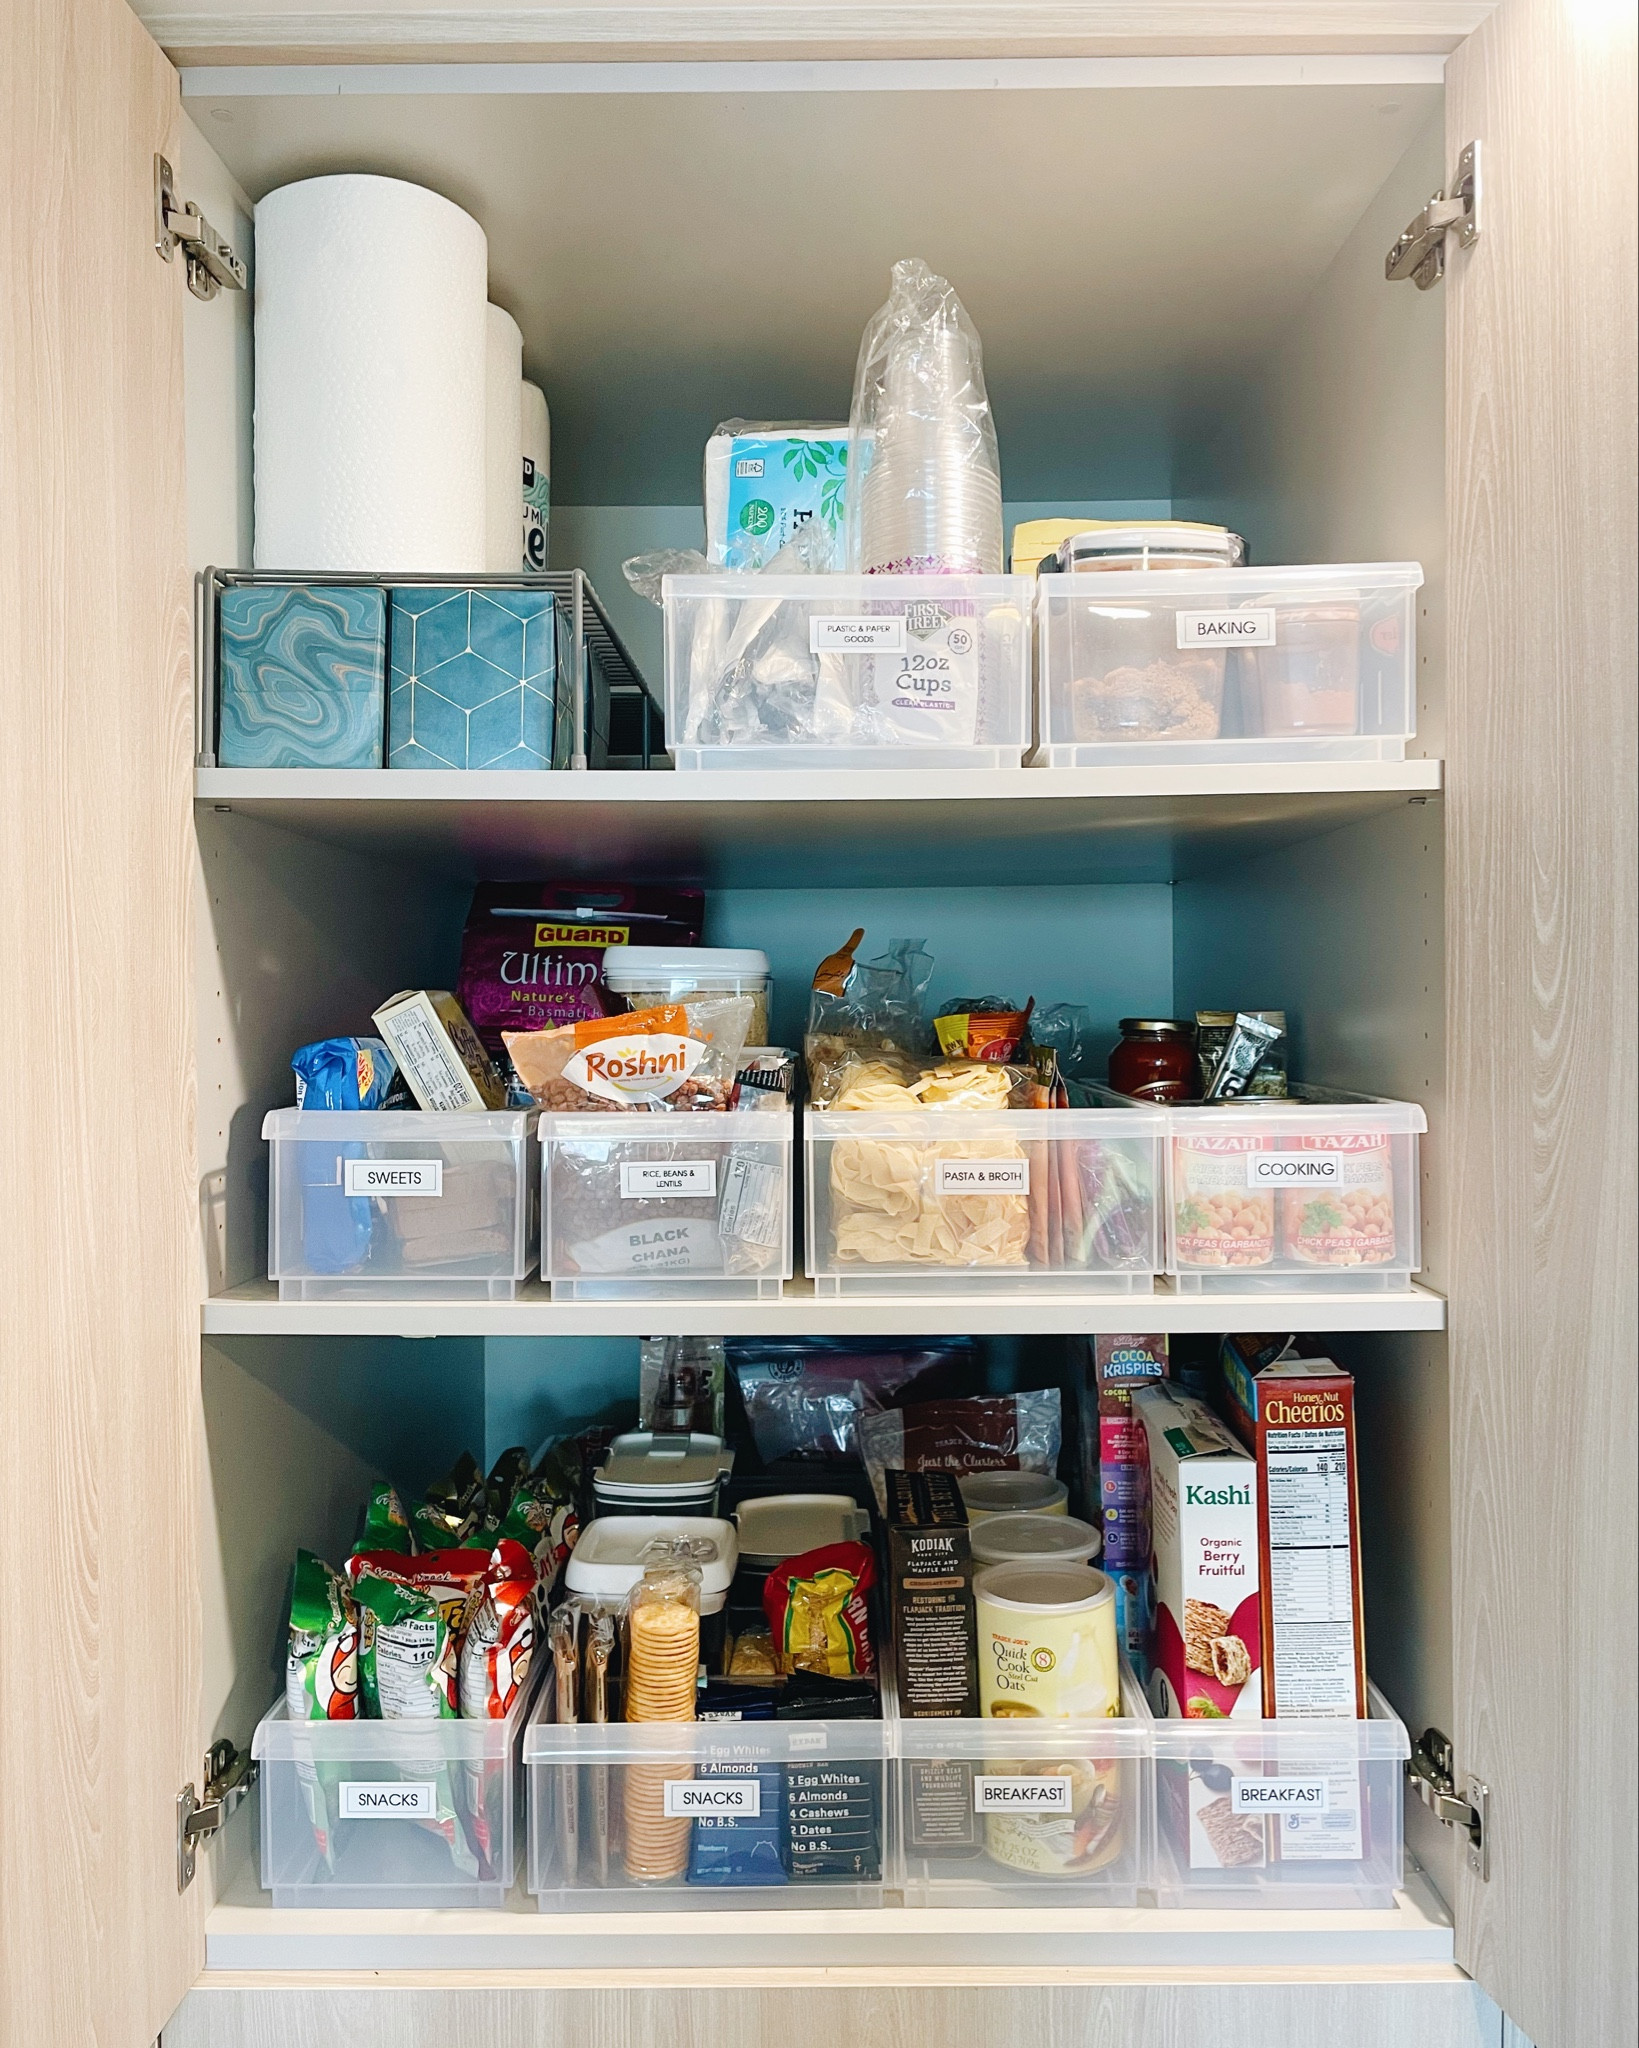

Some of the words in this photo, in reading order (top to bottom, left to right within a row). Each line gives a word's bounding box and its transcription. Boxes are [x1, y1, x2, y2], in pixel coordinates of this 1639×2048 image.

[757, 506, 768, 528] 200
[904, 603, 941, 617] FIRST
[1198, 621, 1256, 635] BAKING
[953, 634, 968, 645] 50
[901, 654, 950, 672] 12oz
[896, 674, 952, 696] Cups
[511, 990, 576, 1004] Nature's
[528, 1006, 585, 1018] Basmati
[586, 1044, 686, 1082] Roshni
[1184, 1137, 1256, 1150] TAZAH
[1310, 1134, 1381, 1148] TAZAH
[663, 1170, 688, 1178] BEANS
[1258, 1163, 1334, 1175] COOKING
[368, 1172, 421, 1184] SWEETS
[945, 1172, 974, 1181] PASTA
[978, 1172, 985, 1181] &
[989, 1172, 1021, 1181] BROTH
[630, 1228, 688, 1246] BLACK
[1192, 1238, 1217, 1248] PEAS
[1297, 1237, 1322, 1246] CHICK
[1324, 1238, 1352, 1247] PEAS
[632, 1246, 690, 1262] CHANA
[1110, 1350, 1155, 1364] COCOA
[1103, 1362, 1163, 1378] KRISPIES
[1294, 1392, 1322, 1405] Honey
[1324, 1392, 1338, 1402] Nut
[1265, 1400, 1344, 1424] Cheerios
[917, 1454, 942, 1472] Just
[944, 1454, 960, 1467] the
[964, 1453, 1007, 1467] Clusters
[1316, 1463, 1328, 1471] 140
[1335, 1462, 1346, 1470] 210
[1186, 1484, 1250, 1504] Kashi
[911, 1538, 954, 1554] KODIAK
[1200, 1538, 1242, 1548] Organic
[1204, 1550, 1240, 1564] Berry
[1199, 1564, 1245, 1576] Fruitful
[912, 1596, 946, 1604] RESTORING
[848, 1596, 867, 1625] RN
[903, 1606, 933, 1614] FLAPJACK
[934, 1604, 966, 1613] TRADITION
[409, 1622, 435, 1631] Facts
[378, 1645, 402, 1659] Calories
[413, 1651, 435, 1662] 110
[992, 1641, 1027, 1662] Quick
[997, 1656, 1030, 1673] Cook
[1039, 1654, 1048, 1666] 8
[996, 1674, 1025, 1691] Oats
[1008, 1672, 1023, 1680] Steel
[1024, 1674, 1038, 1682] Cut
[710, 1745, 730, 1757] Egg
[732, 1745, 771, 1754] Whites
[700, 1764, 707, 1773] 6
[710, 1763, 759, 1773] Almonds
[788, 1776, 795, 1785] 3
[798, 1776, 818, 1786] Egg
[821, 1774, 860, 1784] Whites
[359, 1793, 418, 1806] SNACKS
[683, 1792, 742, 1805] SNACKS
[789, 1793, 795, 1802] 6
[799, 1790, 848, 1801] Almonds
[985, 1788, 1063, 1800] BREAKFAST
[1241, 1788, 1320, 1801] BREAKFAST
[790, 1809, 796, 1818] 4
[799, 1807, 849, 1817] Cashews
[698, 1818, 714, 1827] No
[717, 1818, 738, 1827] B.S.
[791, 1826, 797, 1834] 2
[800, 1825, 832, 1834] Dates
[791, 1842, 805, 1851] No
[809, 1841, 831, 1850] B.S.
